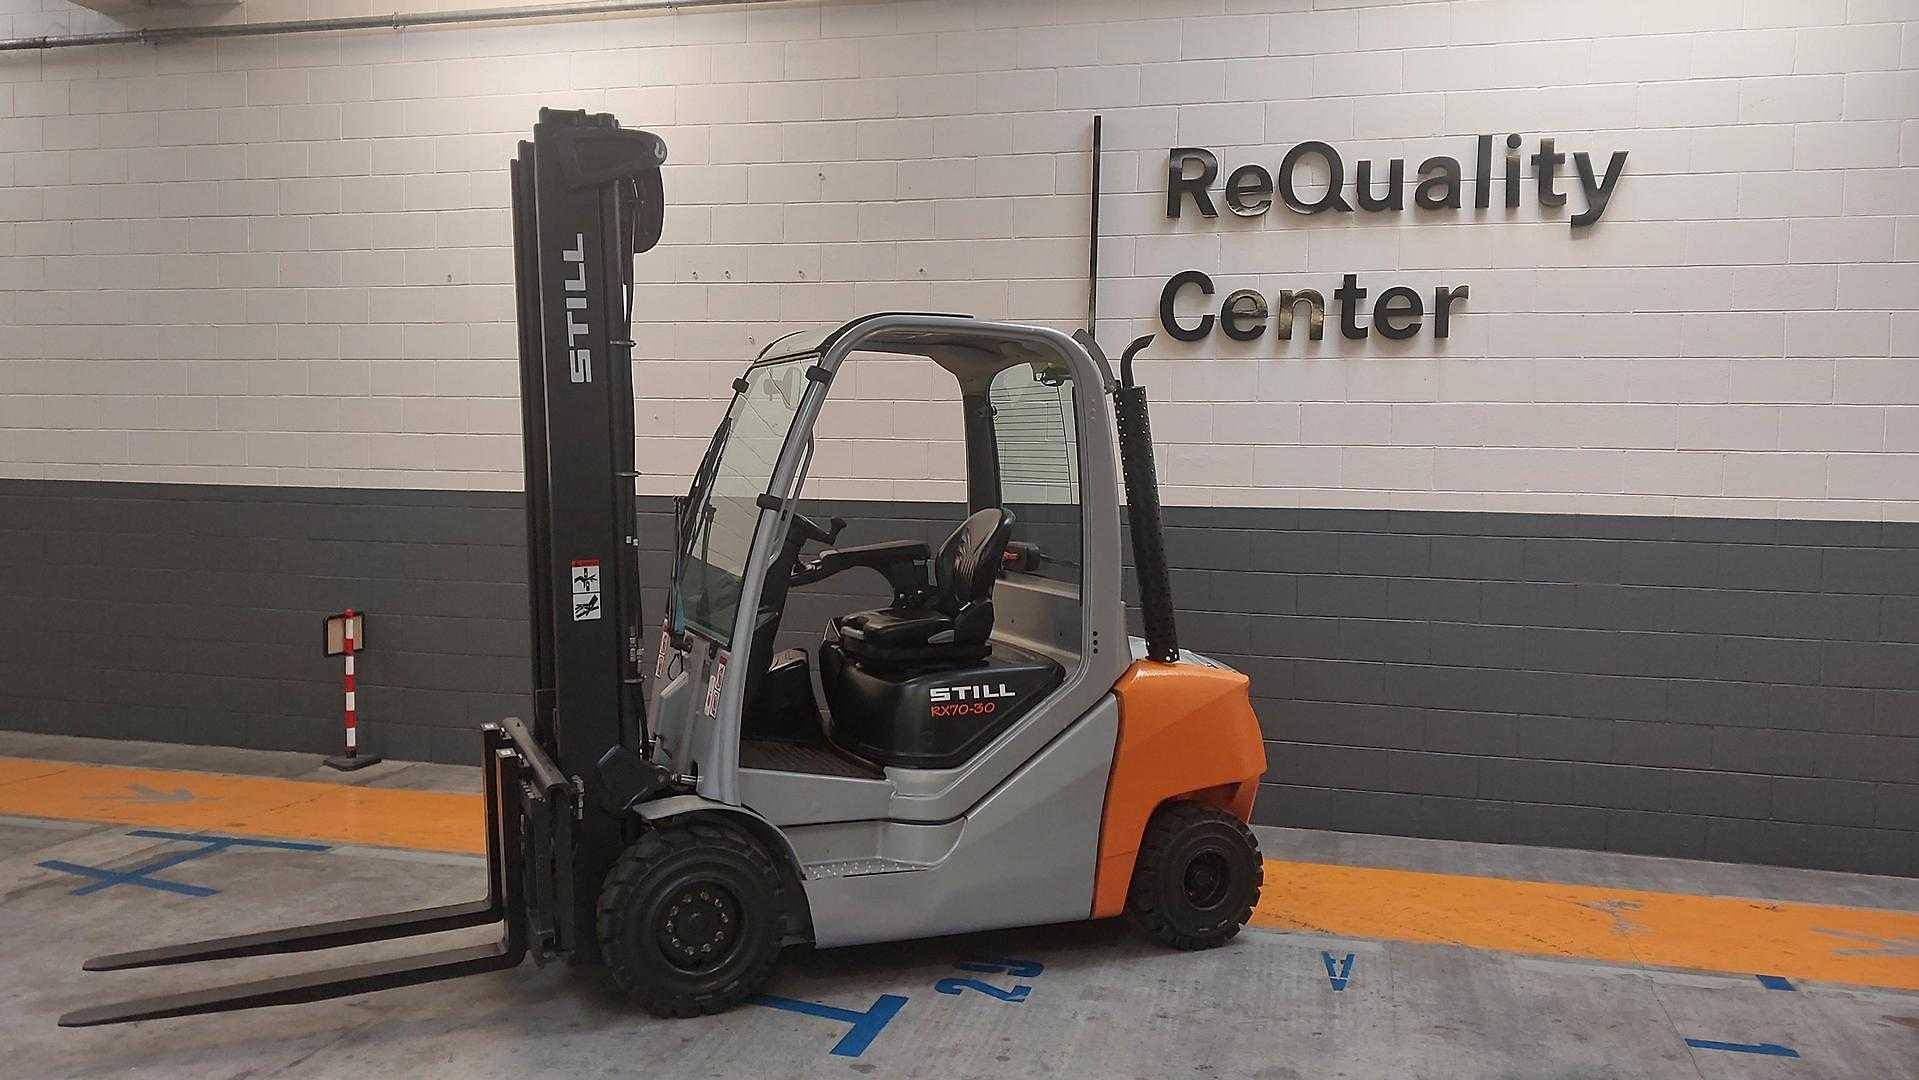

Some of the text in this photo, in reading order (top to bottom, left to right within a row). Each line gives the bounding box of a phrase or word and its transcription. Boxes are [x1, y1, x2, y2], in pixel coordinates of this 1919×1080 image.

[1166, 133, 1629, 229] ReQuality
[562, 232, 593, 384] STILL
[1159, 270, 1469, 343] Center
[930, 683, 1016, 702] STILL
[931, 702, 995, 718] RX70-30
